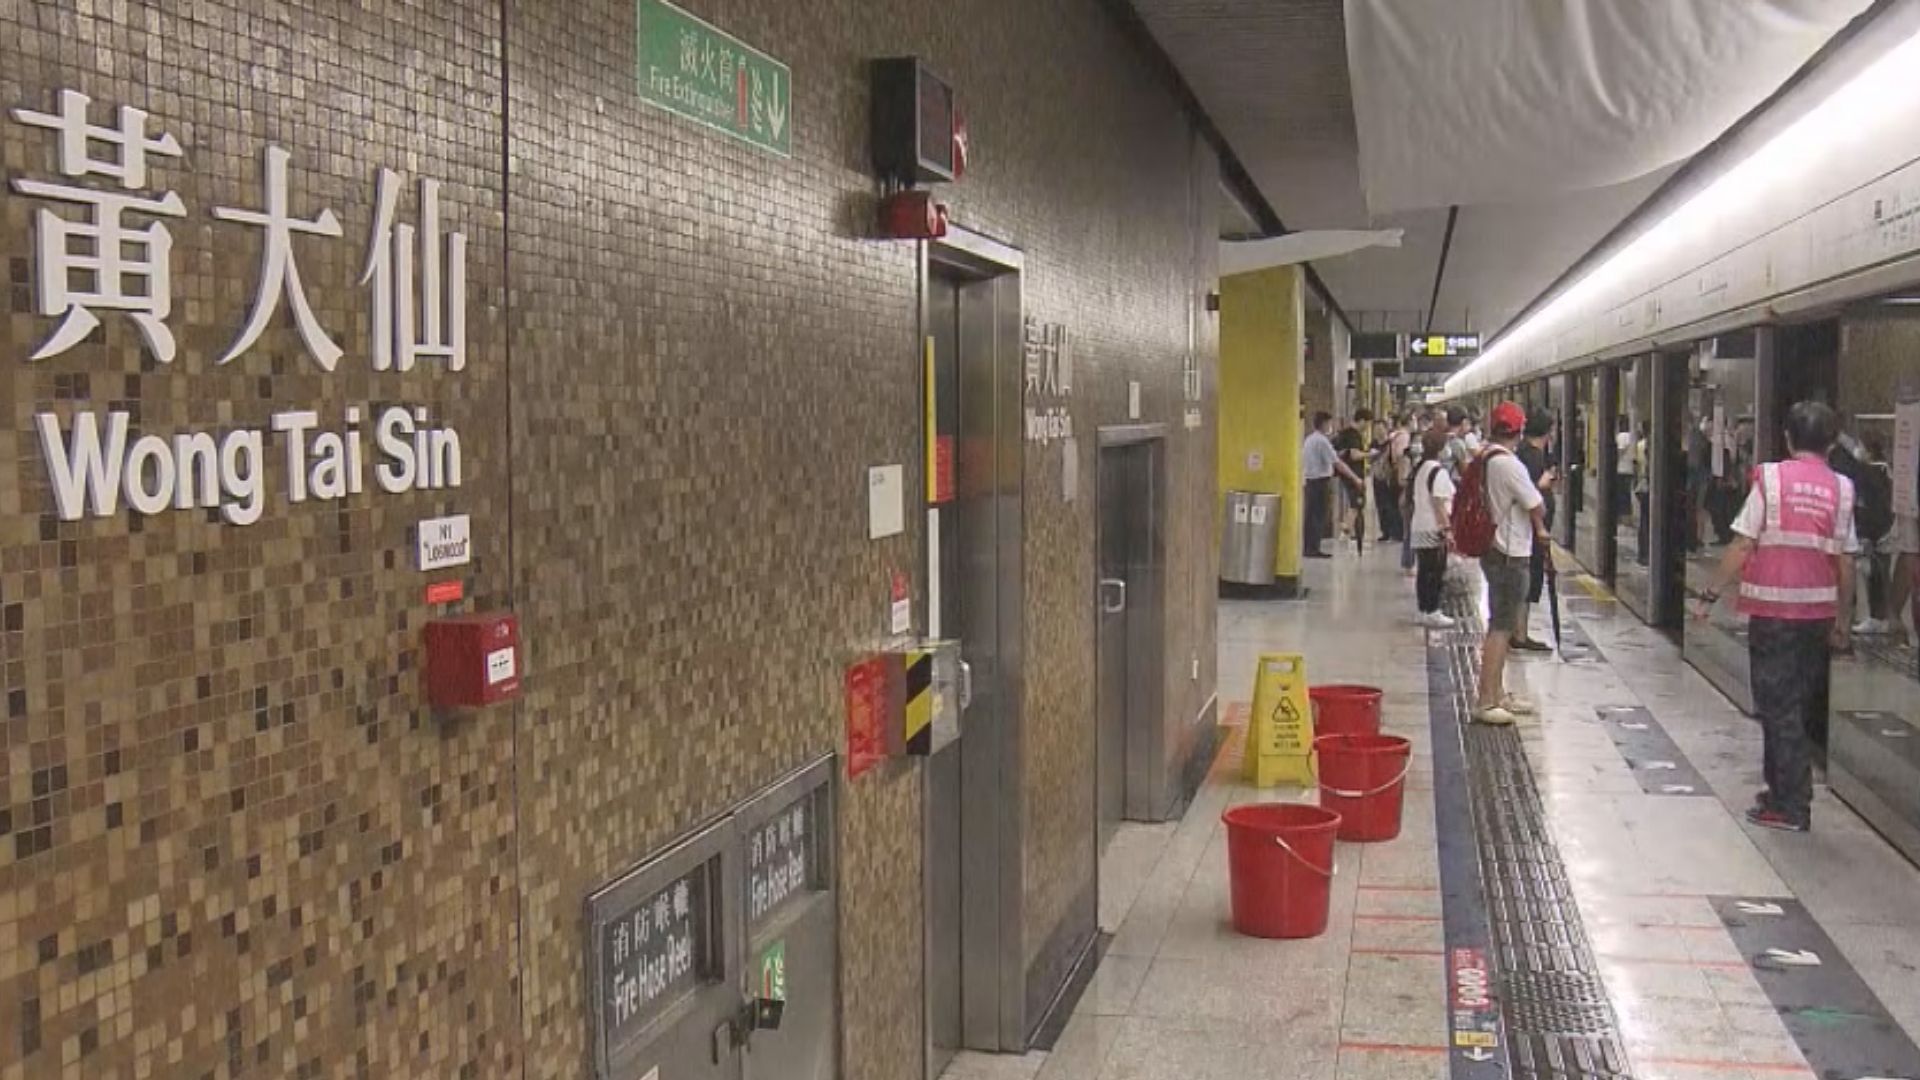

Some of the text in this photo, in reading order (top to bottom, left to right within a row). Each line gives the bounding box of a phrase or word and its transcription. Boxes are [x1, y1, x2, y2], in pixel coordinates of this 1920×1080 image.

[9, 89, 467, 371] 黃大仙
[35, 406, 461, 525] Wong Tai Sin
[614, 920, 692, 1028] Fire Hose Reel
